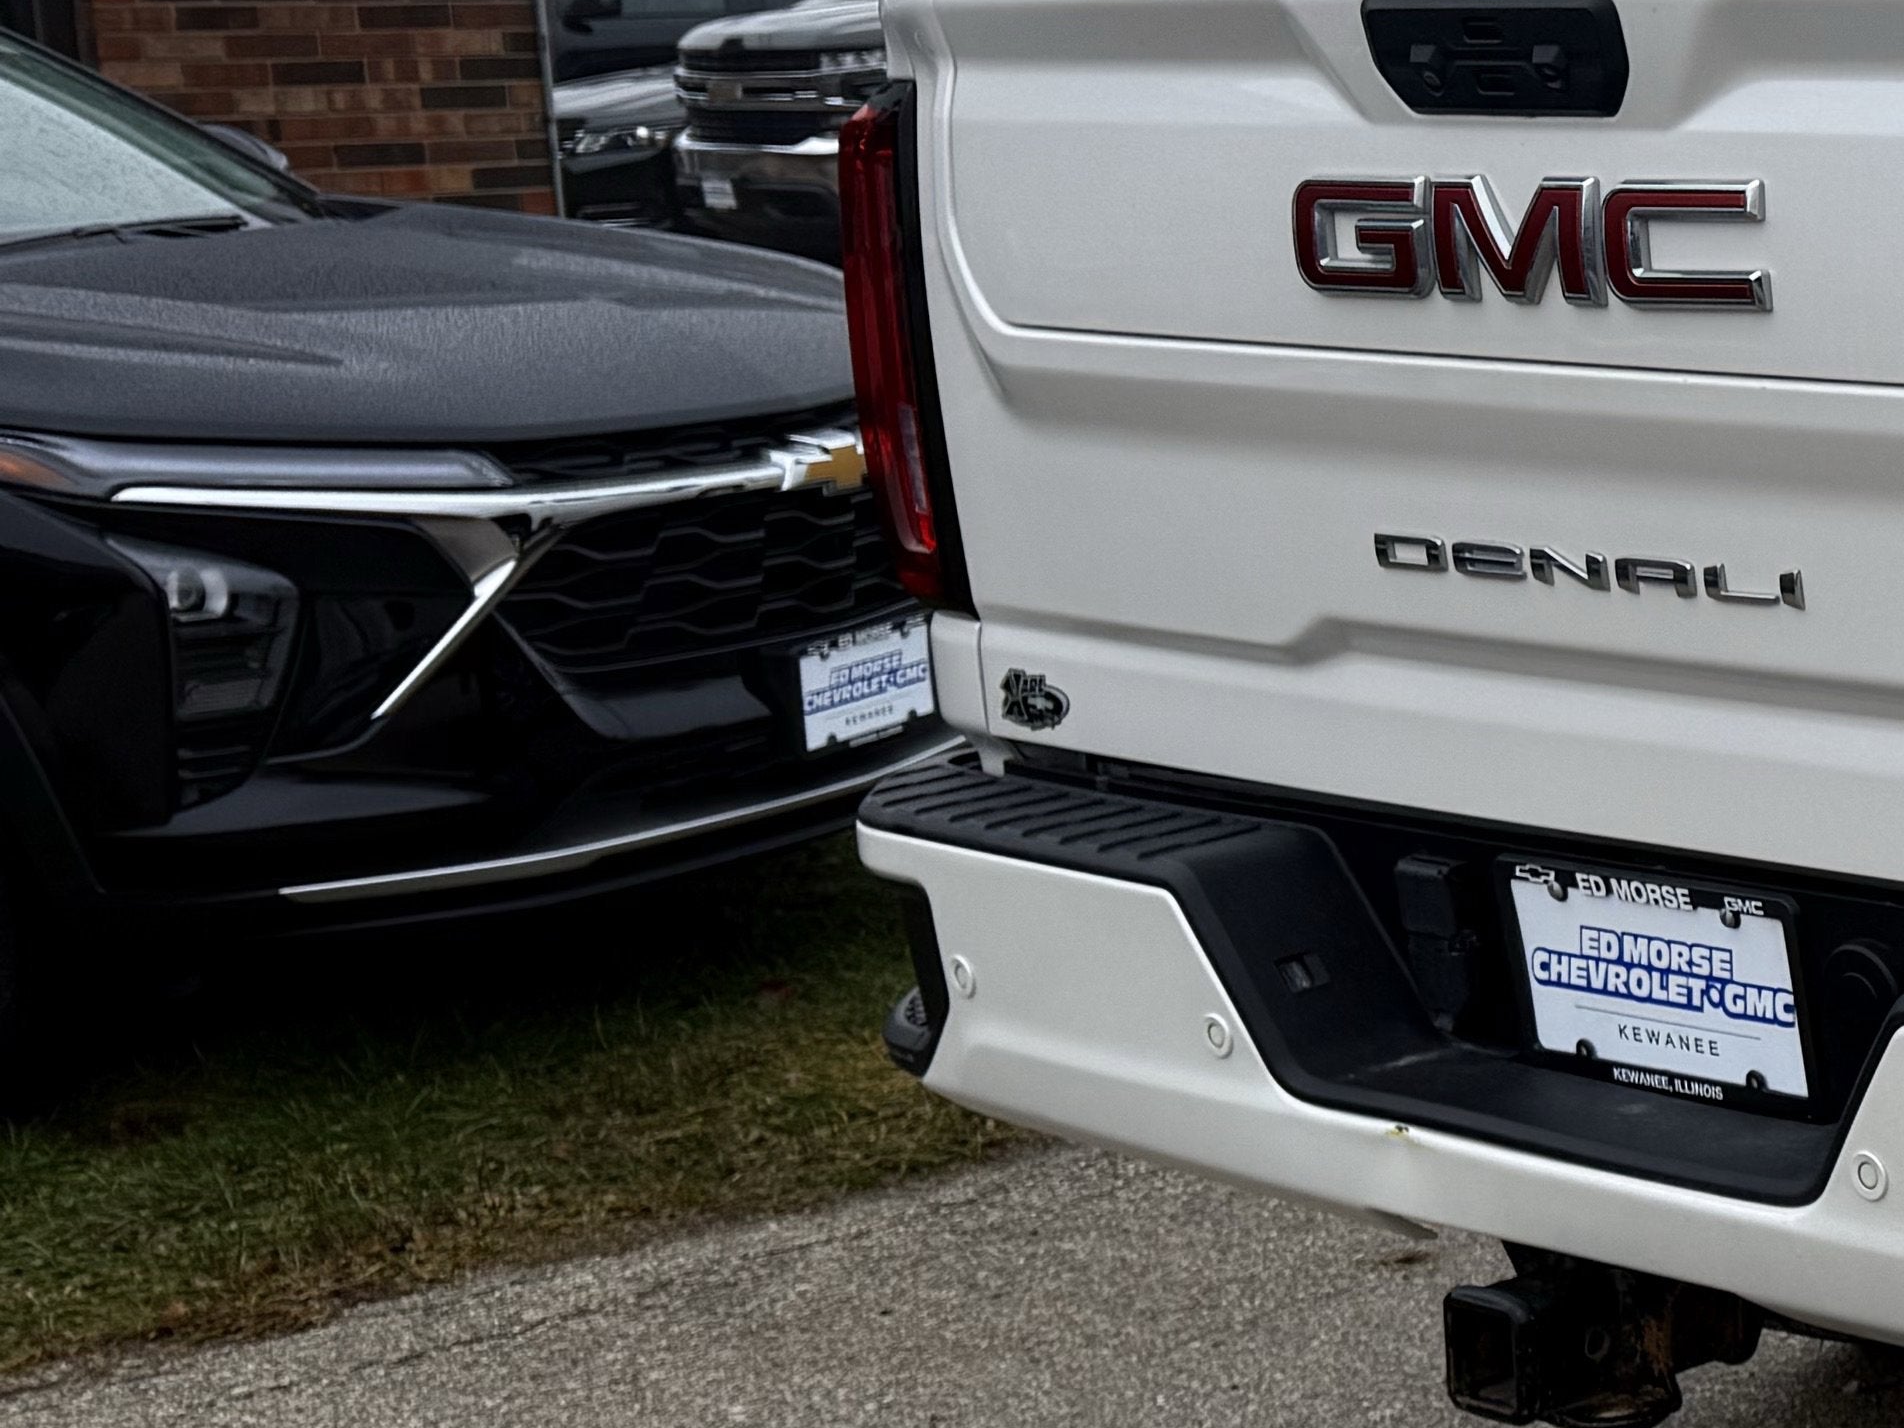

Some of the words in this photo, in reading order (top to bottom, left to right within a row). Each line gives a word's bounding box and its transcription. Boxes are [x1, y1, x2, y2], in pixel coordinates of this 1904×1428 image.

[1291, 175, 1773, 312] GMC
[1373, 531, 1806, 611] DENALI
[1575, 871, 1606, 898] ED
[1610, 877, 1694, 911] MORSE
[1723, 896, 1764, 916] GMC
[1580, 925, 1620, 961] ED
[1621, 932, 1733, 979] MORSE
[1618, 1024, 1720, 1057] KEWANEE
[1613, 1067, 1673, 1093] KEWANEE,
[1674, 1077, 1724, 1101] ILLINOIS
